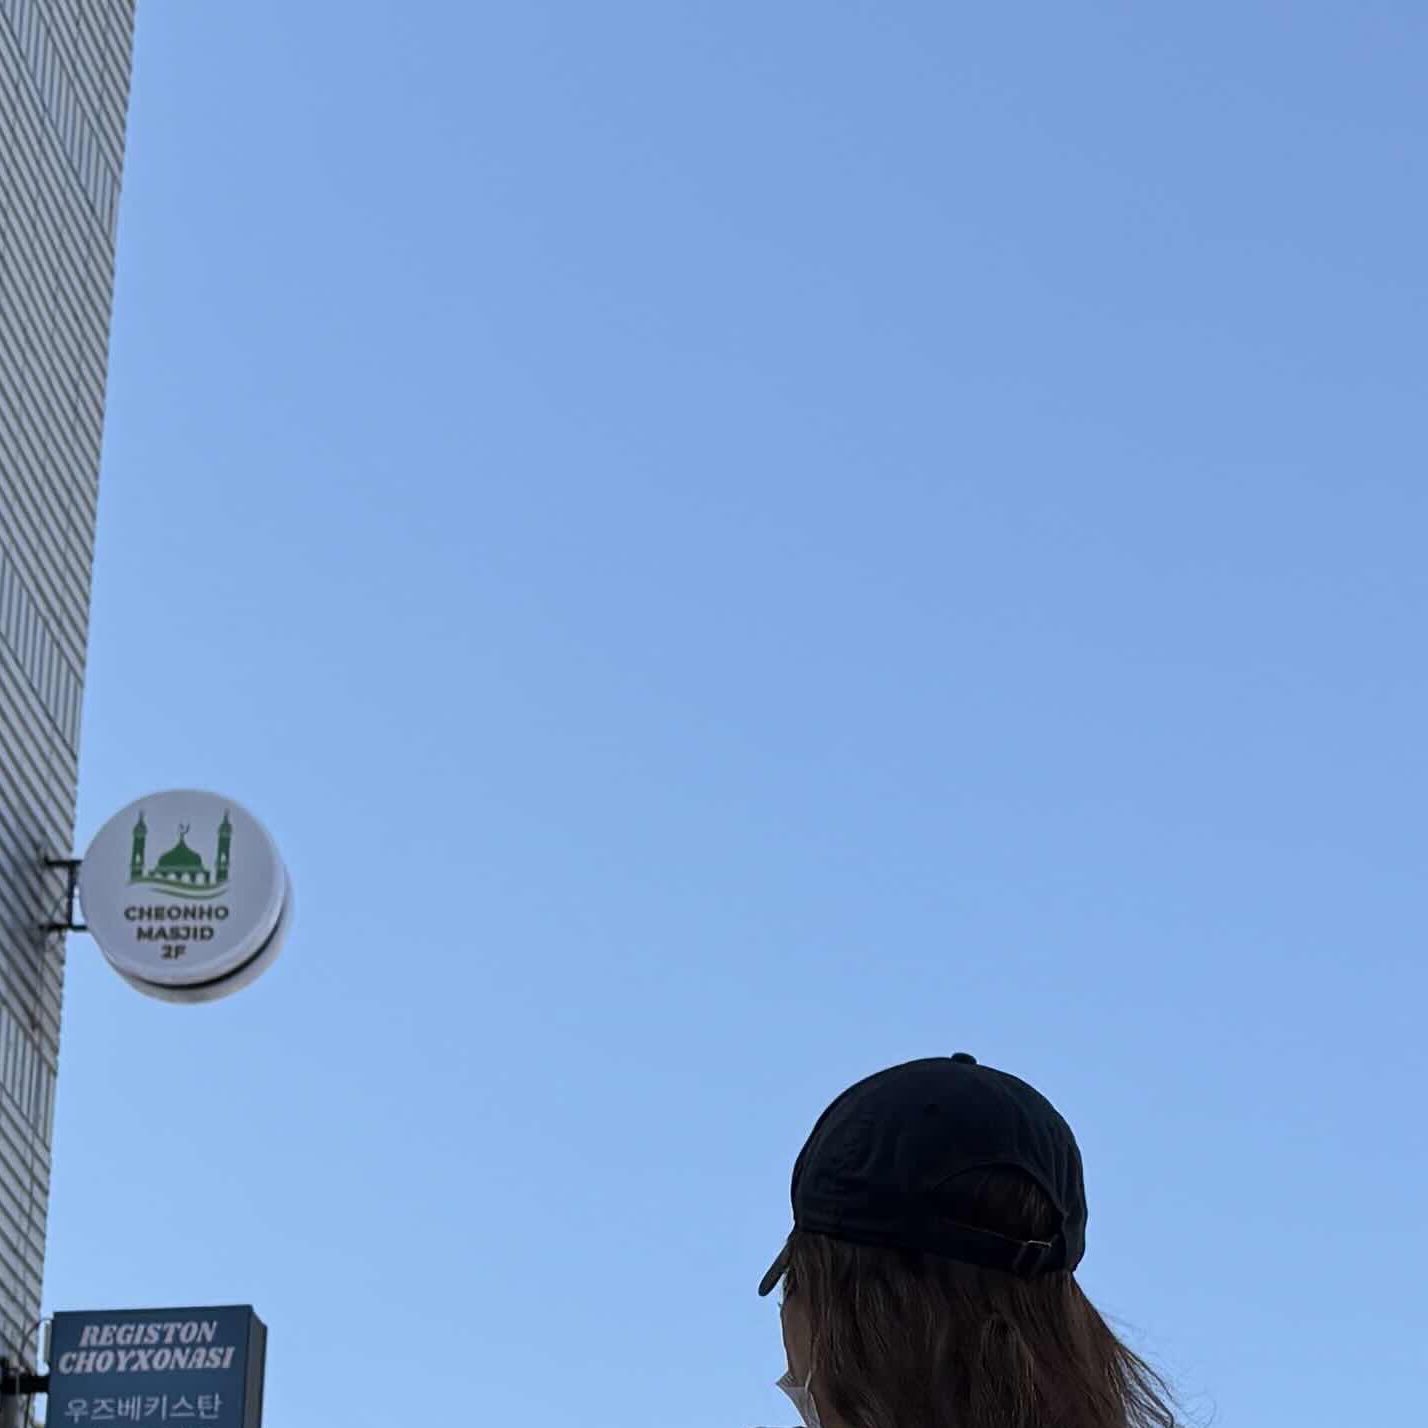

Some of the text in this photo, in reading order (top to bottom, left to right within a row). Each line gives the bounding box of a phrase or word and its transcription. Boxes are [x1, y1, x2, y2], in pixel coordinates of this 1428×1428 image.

[124, 906, 229, 921] CHEONHO
[136, 926, 214, 941] MASJID
[161, 944, 186, 959] 2F
[79, 1320, 217, 1347] REGISTON
[59, 1346, 235, 1374] CHOYXONASI
[64, 1393, 221, 1424] 우즈베키스탄
